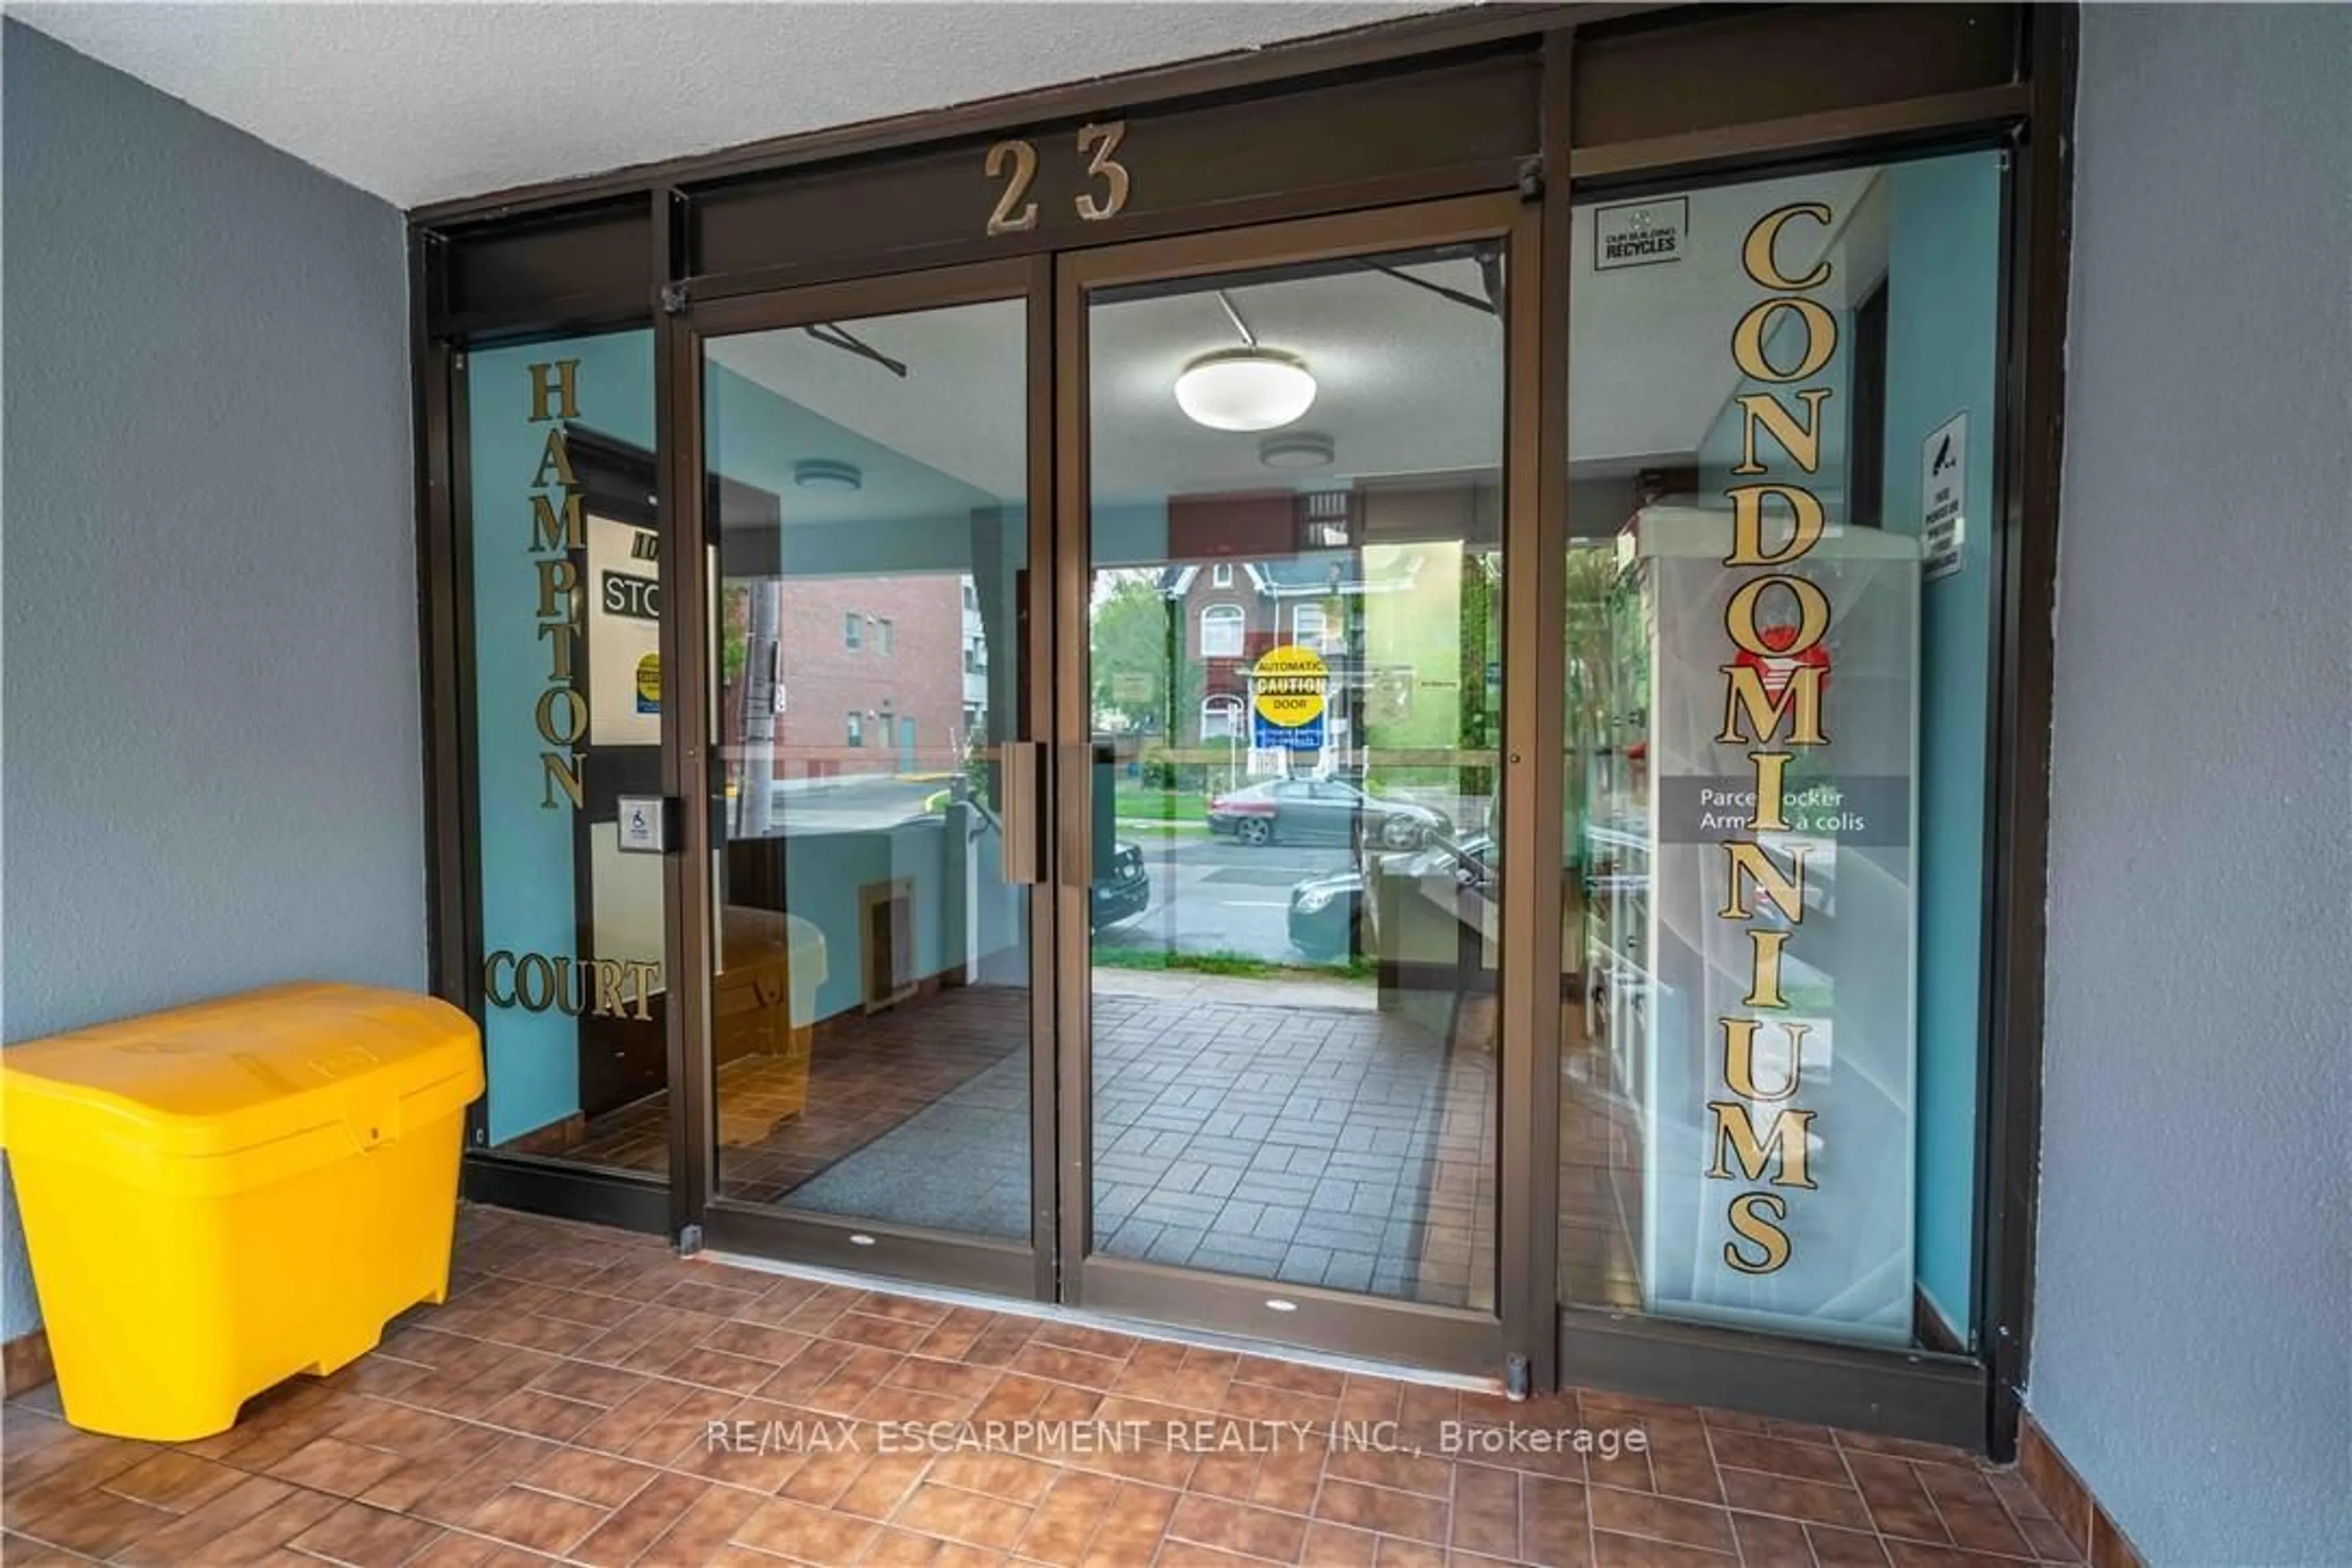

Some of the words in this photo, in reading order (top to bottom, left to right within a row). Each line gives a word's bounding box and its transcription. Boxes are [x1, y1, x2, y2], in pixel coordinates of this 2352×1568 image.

[1607, 236, 1676, 259] RECYCLES
[528, 360, 588, 809] HAMPTON
[1258, 660, 1322, 672] AUTOMATIC
[1257, 677, 1327, 694] CAUTION
[1273, 699, 1307, 709] DOOR
[1705, 203, 1839, 1275] CONDOMINIUMS
[1700, 788, 1756, 807] Parce
[1783, 788, 1844, 807] ocker
[1796, 812, 1808, 830] à
[1816, 812, 1865, 831] colis
[484, 951, 660, 1022] COURT
